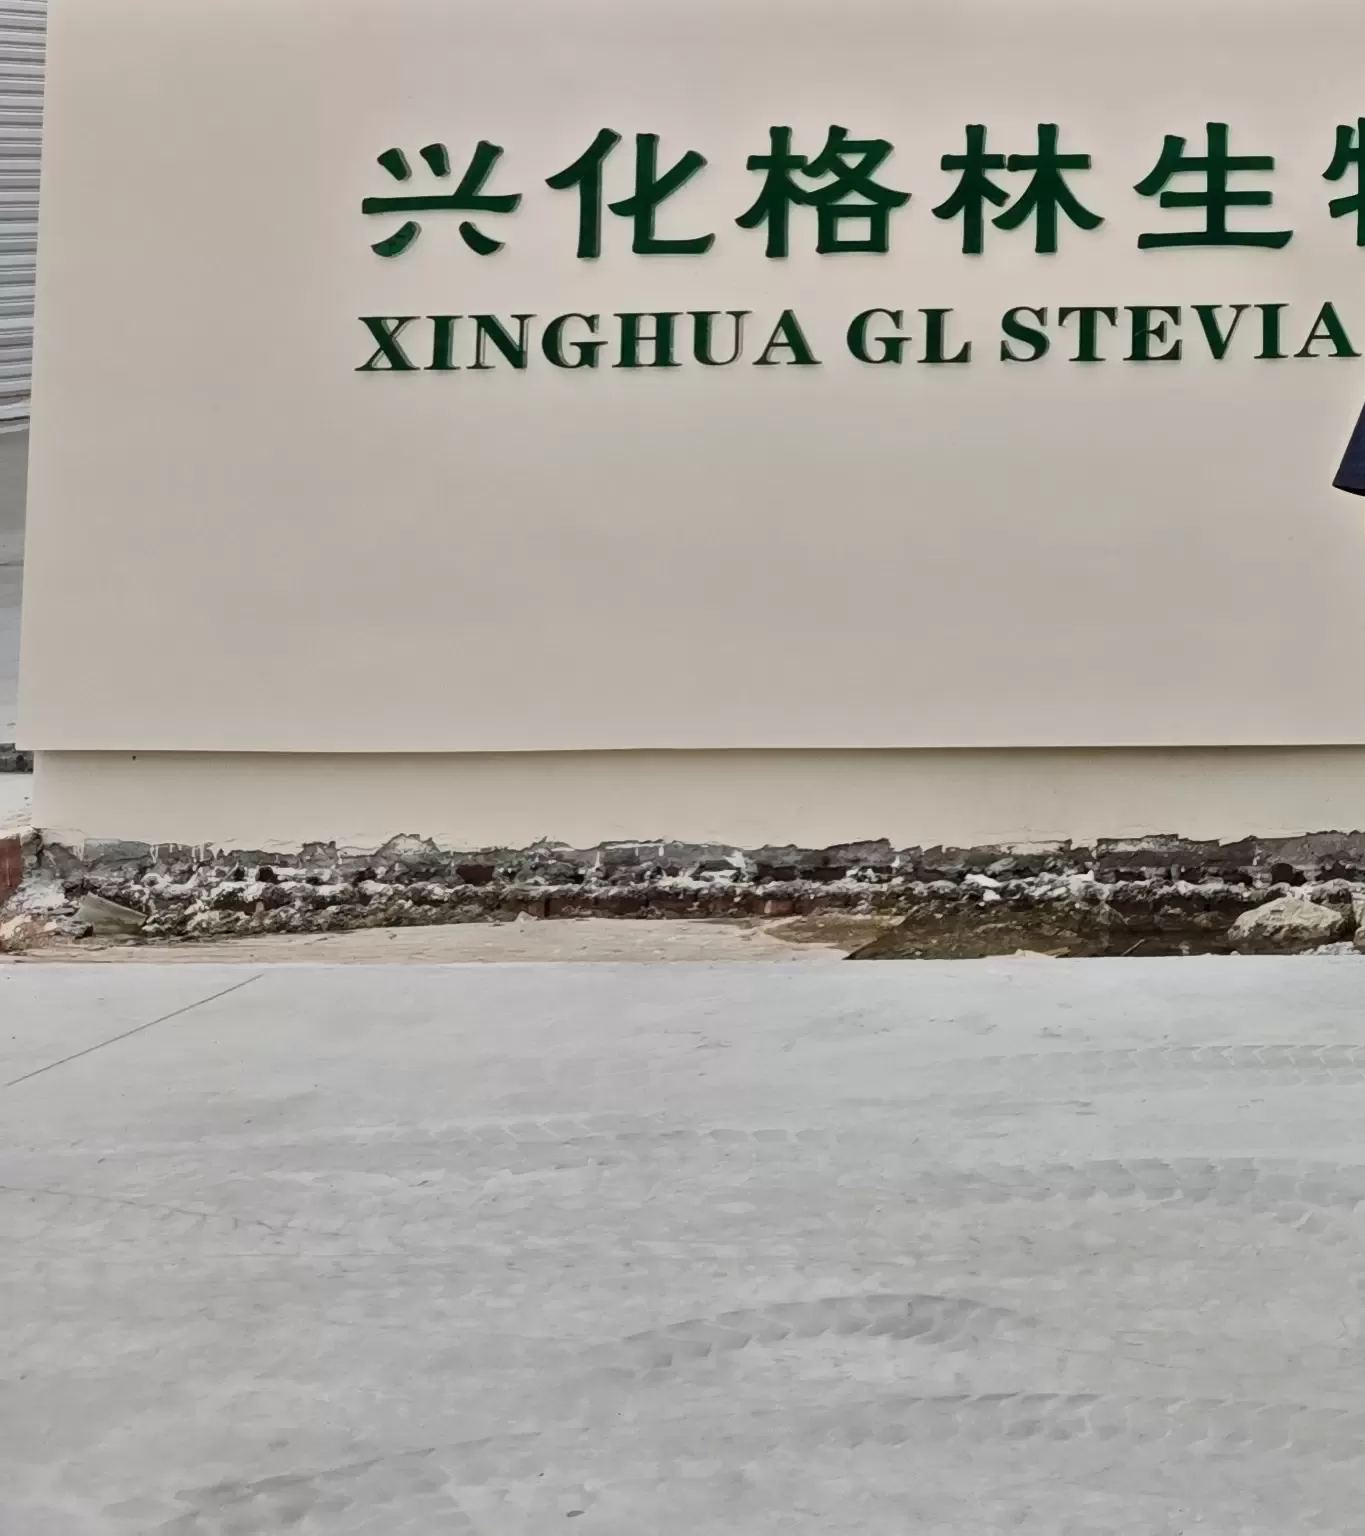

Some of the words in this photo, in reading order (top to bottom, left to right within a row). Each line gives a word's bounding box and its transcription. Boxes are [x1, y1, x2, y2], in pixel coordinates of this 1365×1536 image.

[354, 309, 823, 372] XINGHUA
[846, 307, 972, 365] GL
[999, 301, 1363, 362] STEVIA
